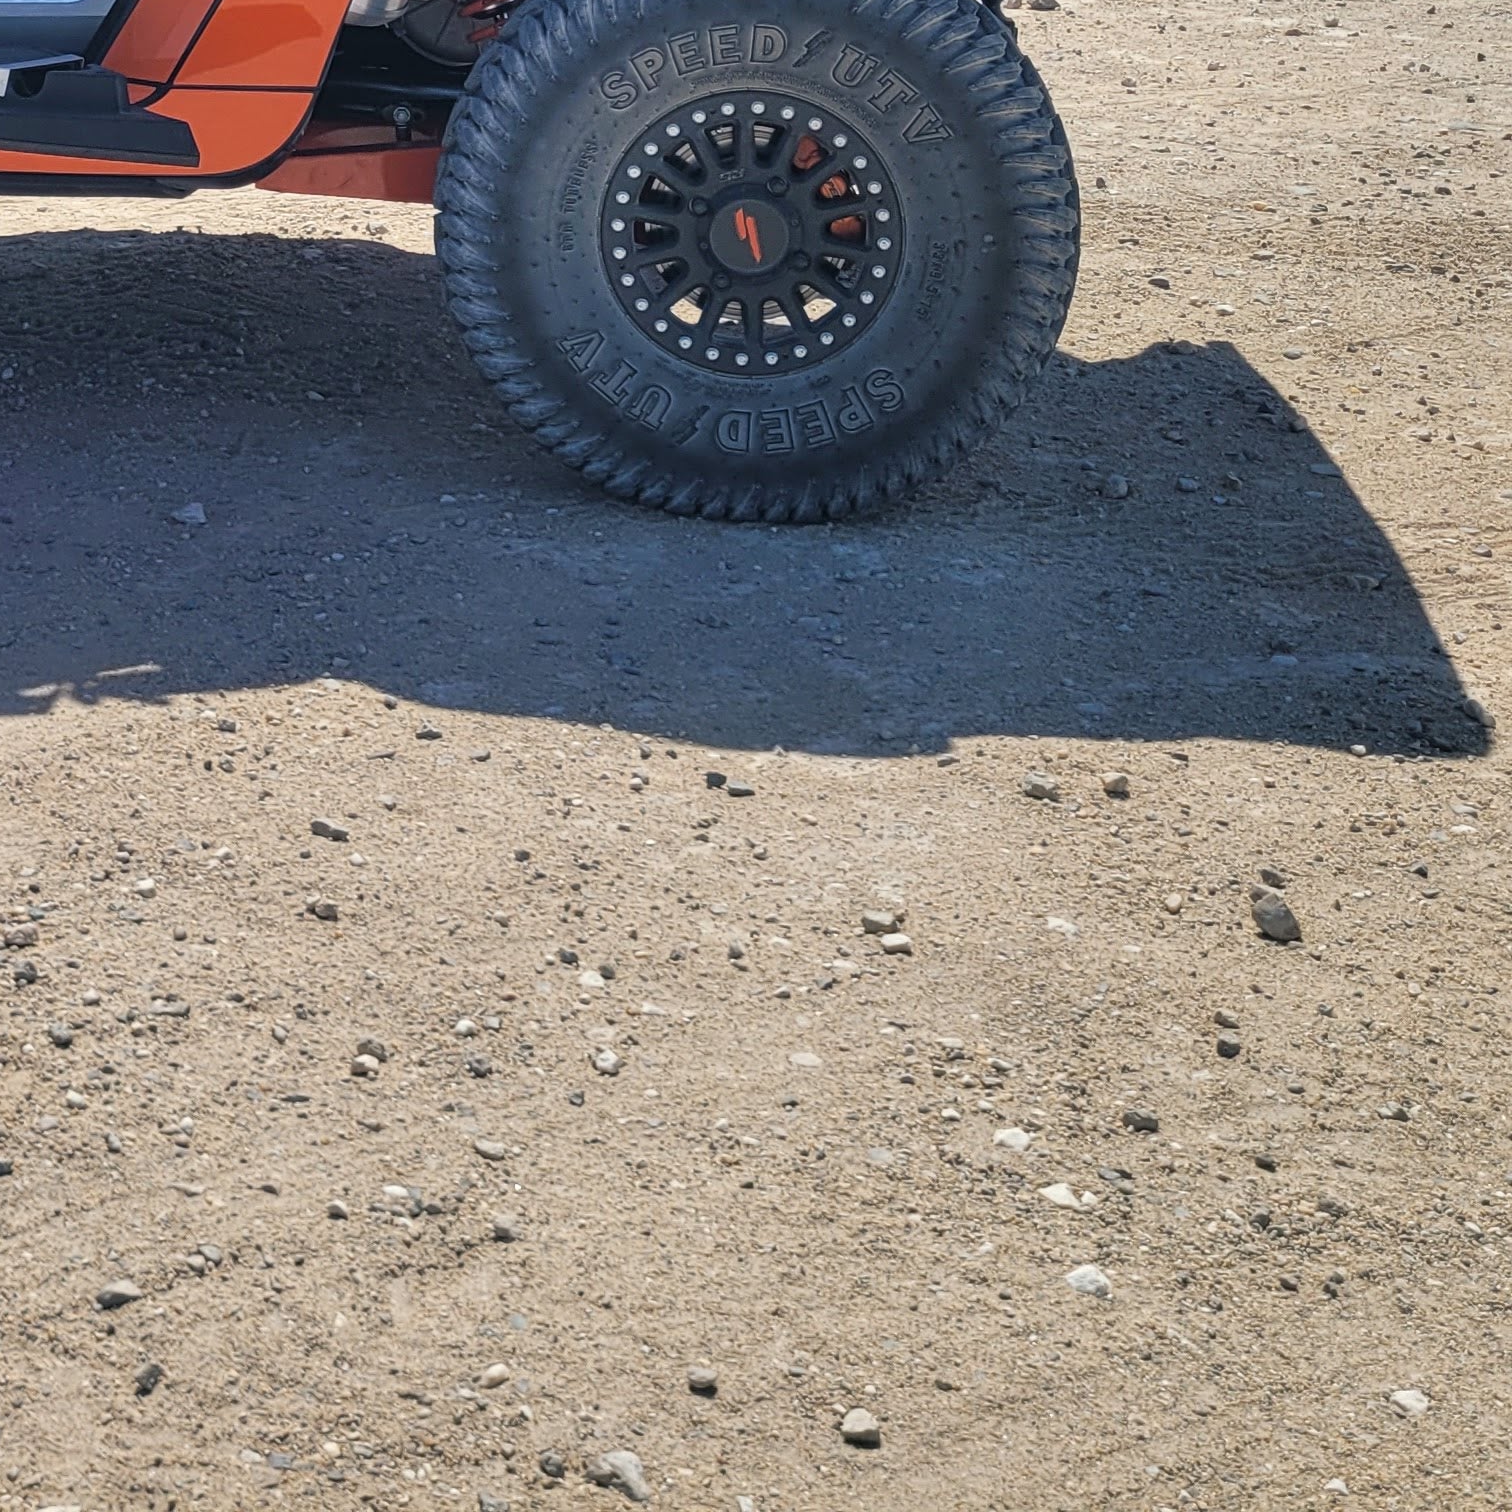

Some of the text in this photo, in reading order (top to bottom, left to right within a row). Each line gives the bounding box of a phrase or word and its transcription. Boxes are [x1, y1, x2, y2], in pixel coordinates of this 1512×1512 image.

[600, 23, 788, 110] SPEED
[830, 42, 954, 144] UTV
[555, 328, 905, 454] SPEED UTV
